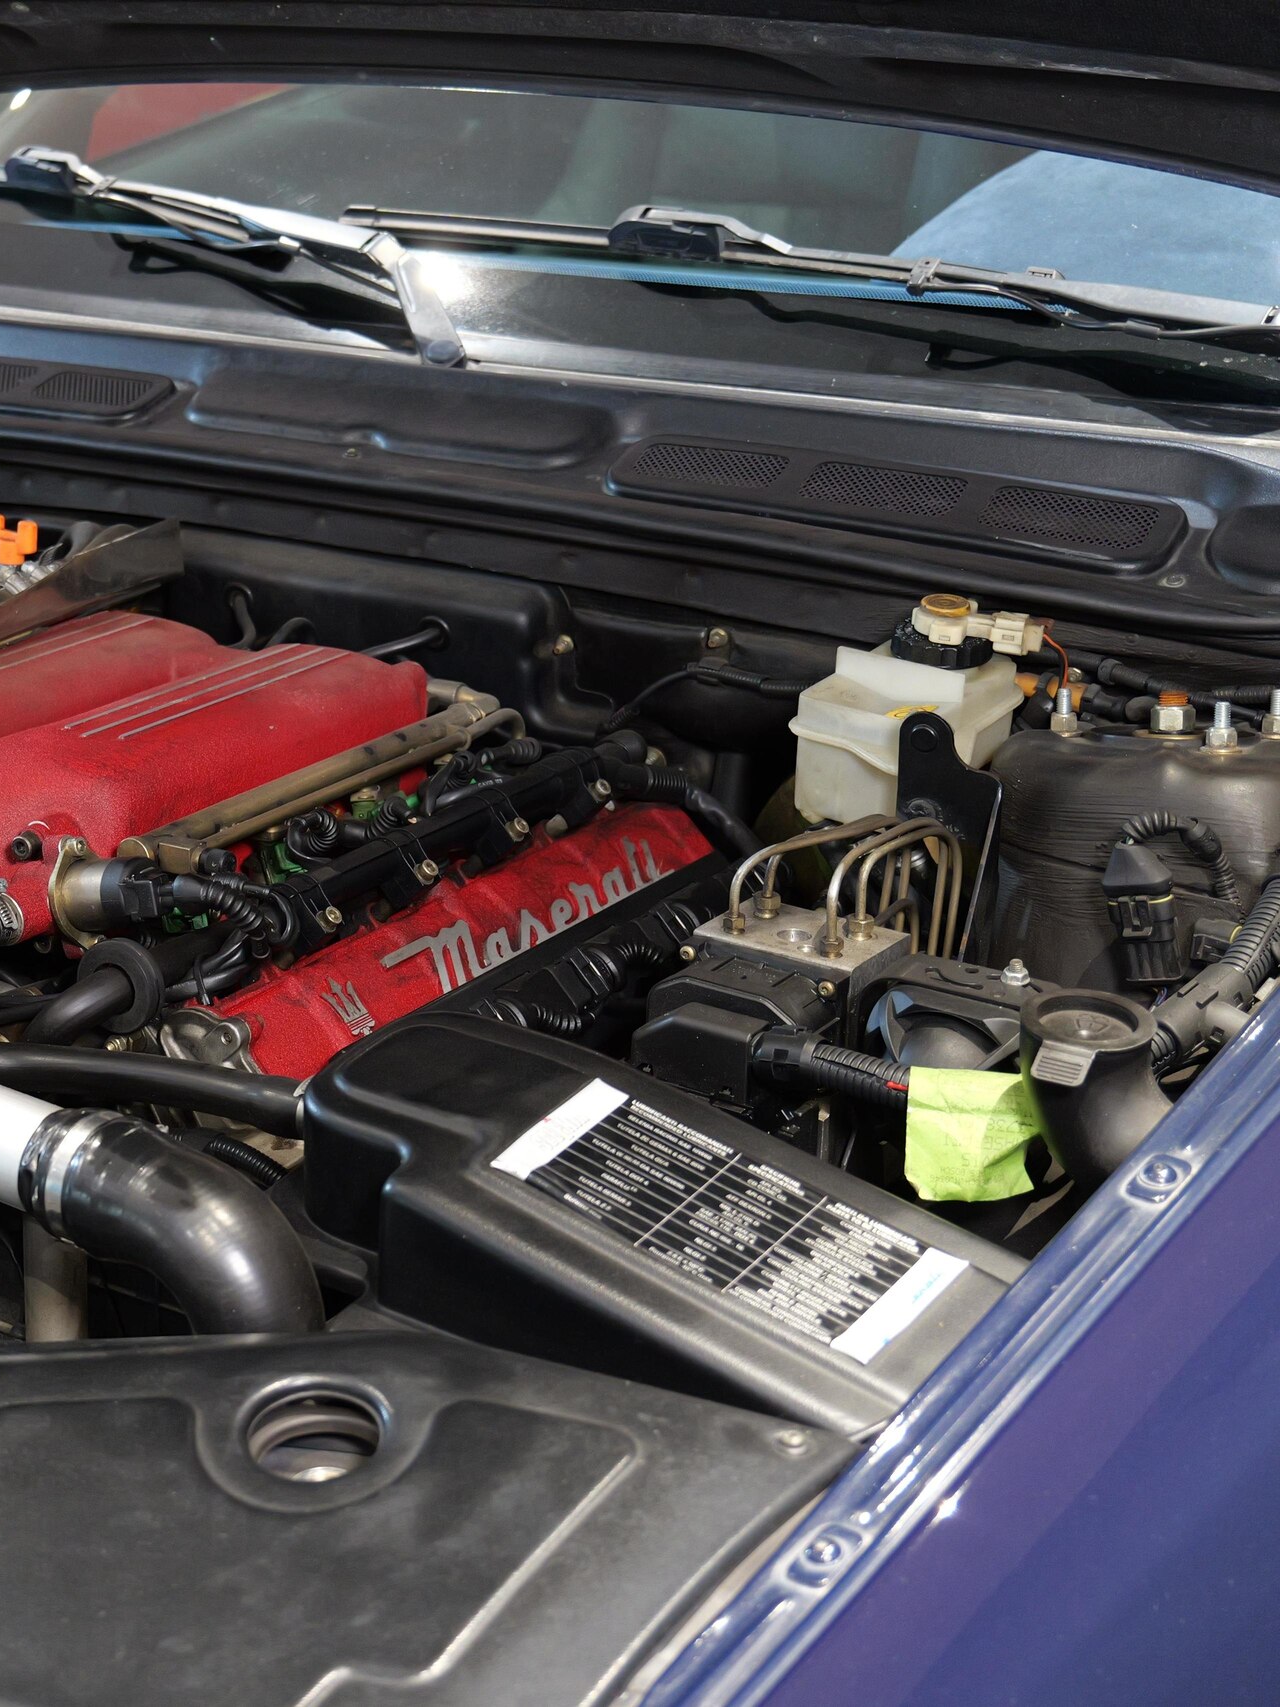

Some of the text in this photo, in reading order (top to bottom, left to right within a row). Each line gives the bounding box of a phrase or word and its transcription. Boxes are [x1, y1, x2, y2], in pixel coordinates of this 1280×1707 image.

[380, 836, 675, 994] Maserati
[617, 1122, 640, 1138] TUTELA
[592, 1138, 616, 1154] TUTELA
[631, 1143, 654, 1160] TUTELA
[605, 1159, 629, 1175] TUTELA
[579, 1175, 602, 1191] TUTELA
